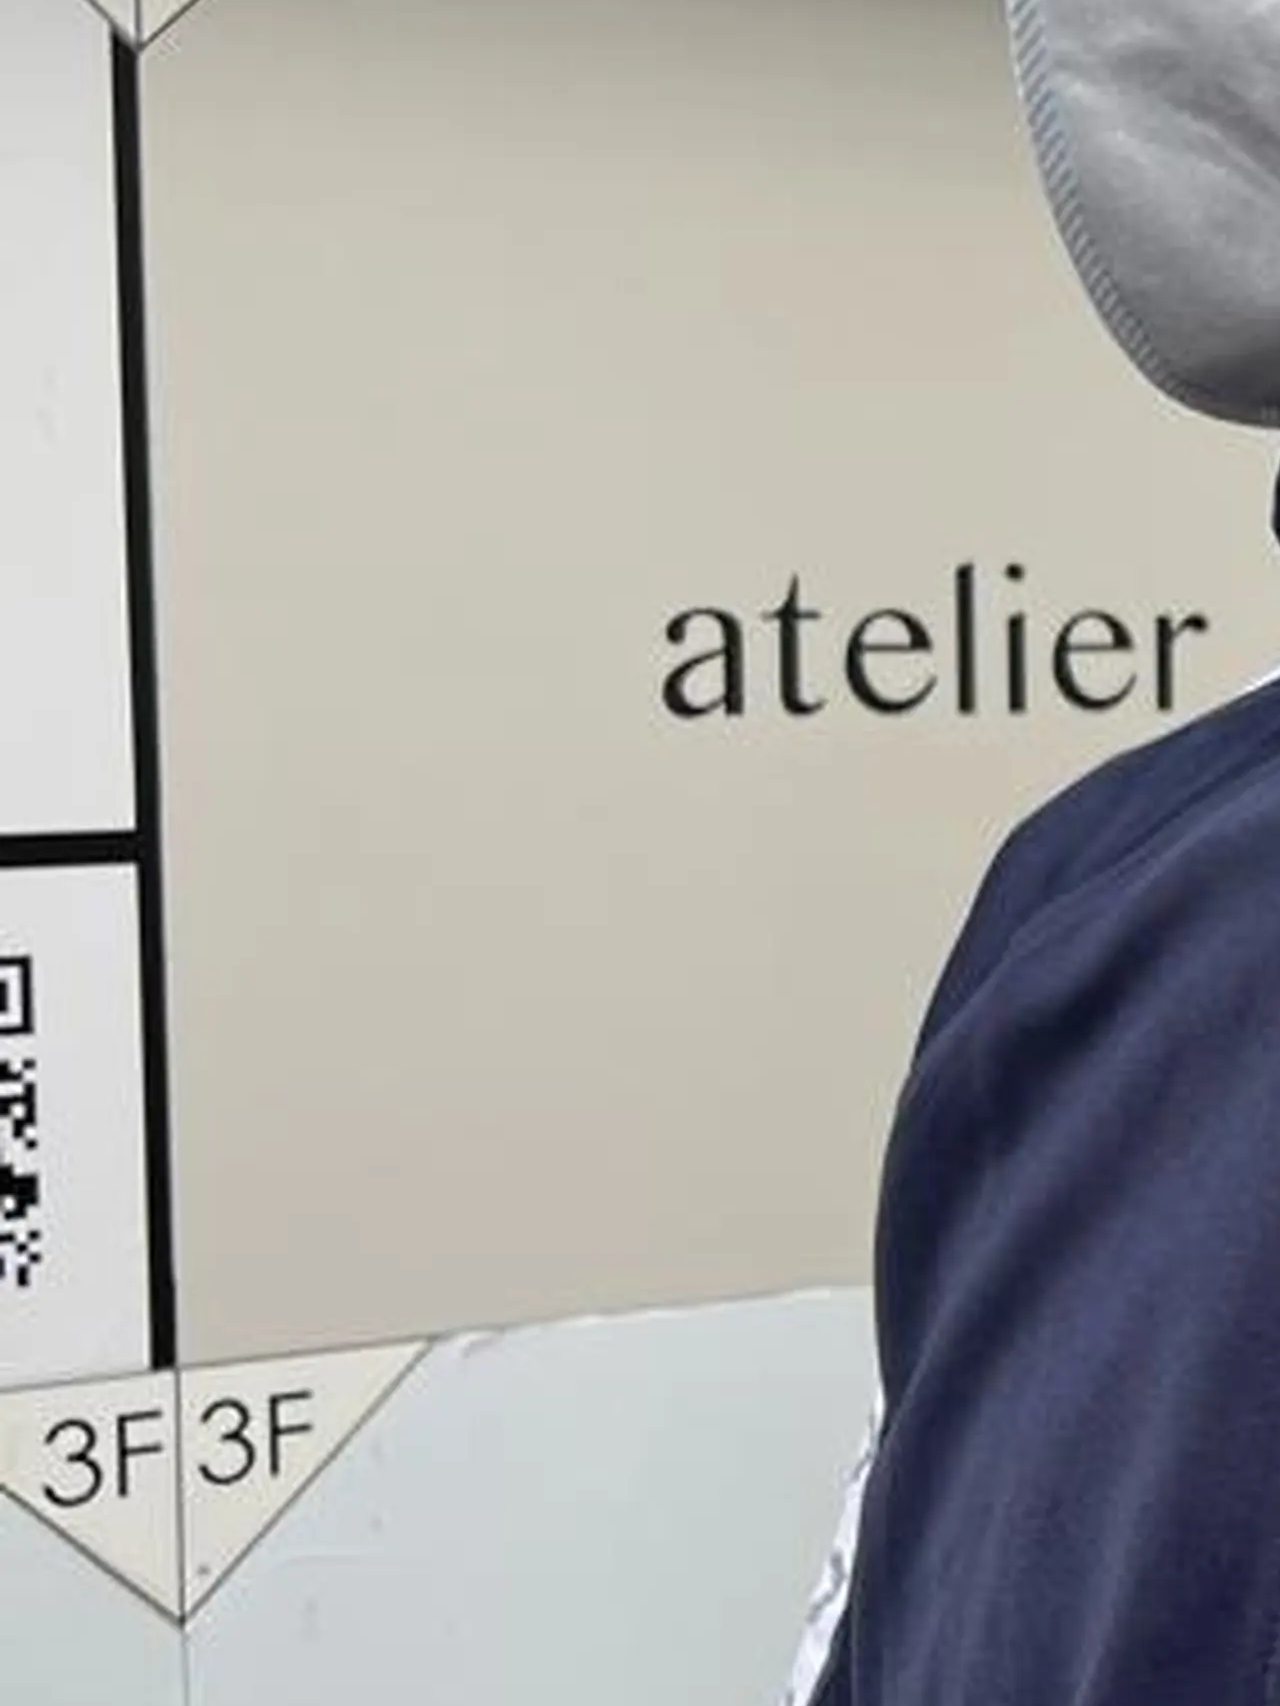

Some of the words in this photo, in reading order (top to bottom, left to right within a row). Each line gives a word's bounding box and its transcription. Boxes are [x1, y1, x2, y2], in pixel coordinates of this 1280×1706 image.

[660, 561, 1210, 720] atelier
[42, 1409, 164, 1509] 3F
[197, 1389, 314, 1486] 3F
